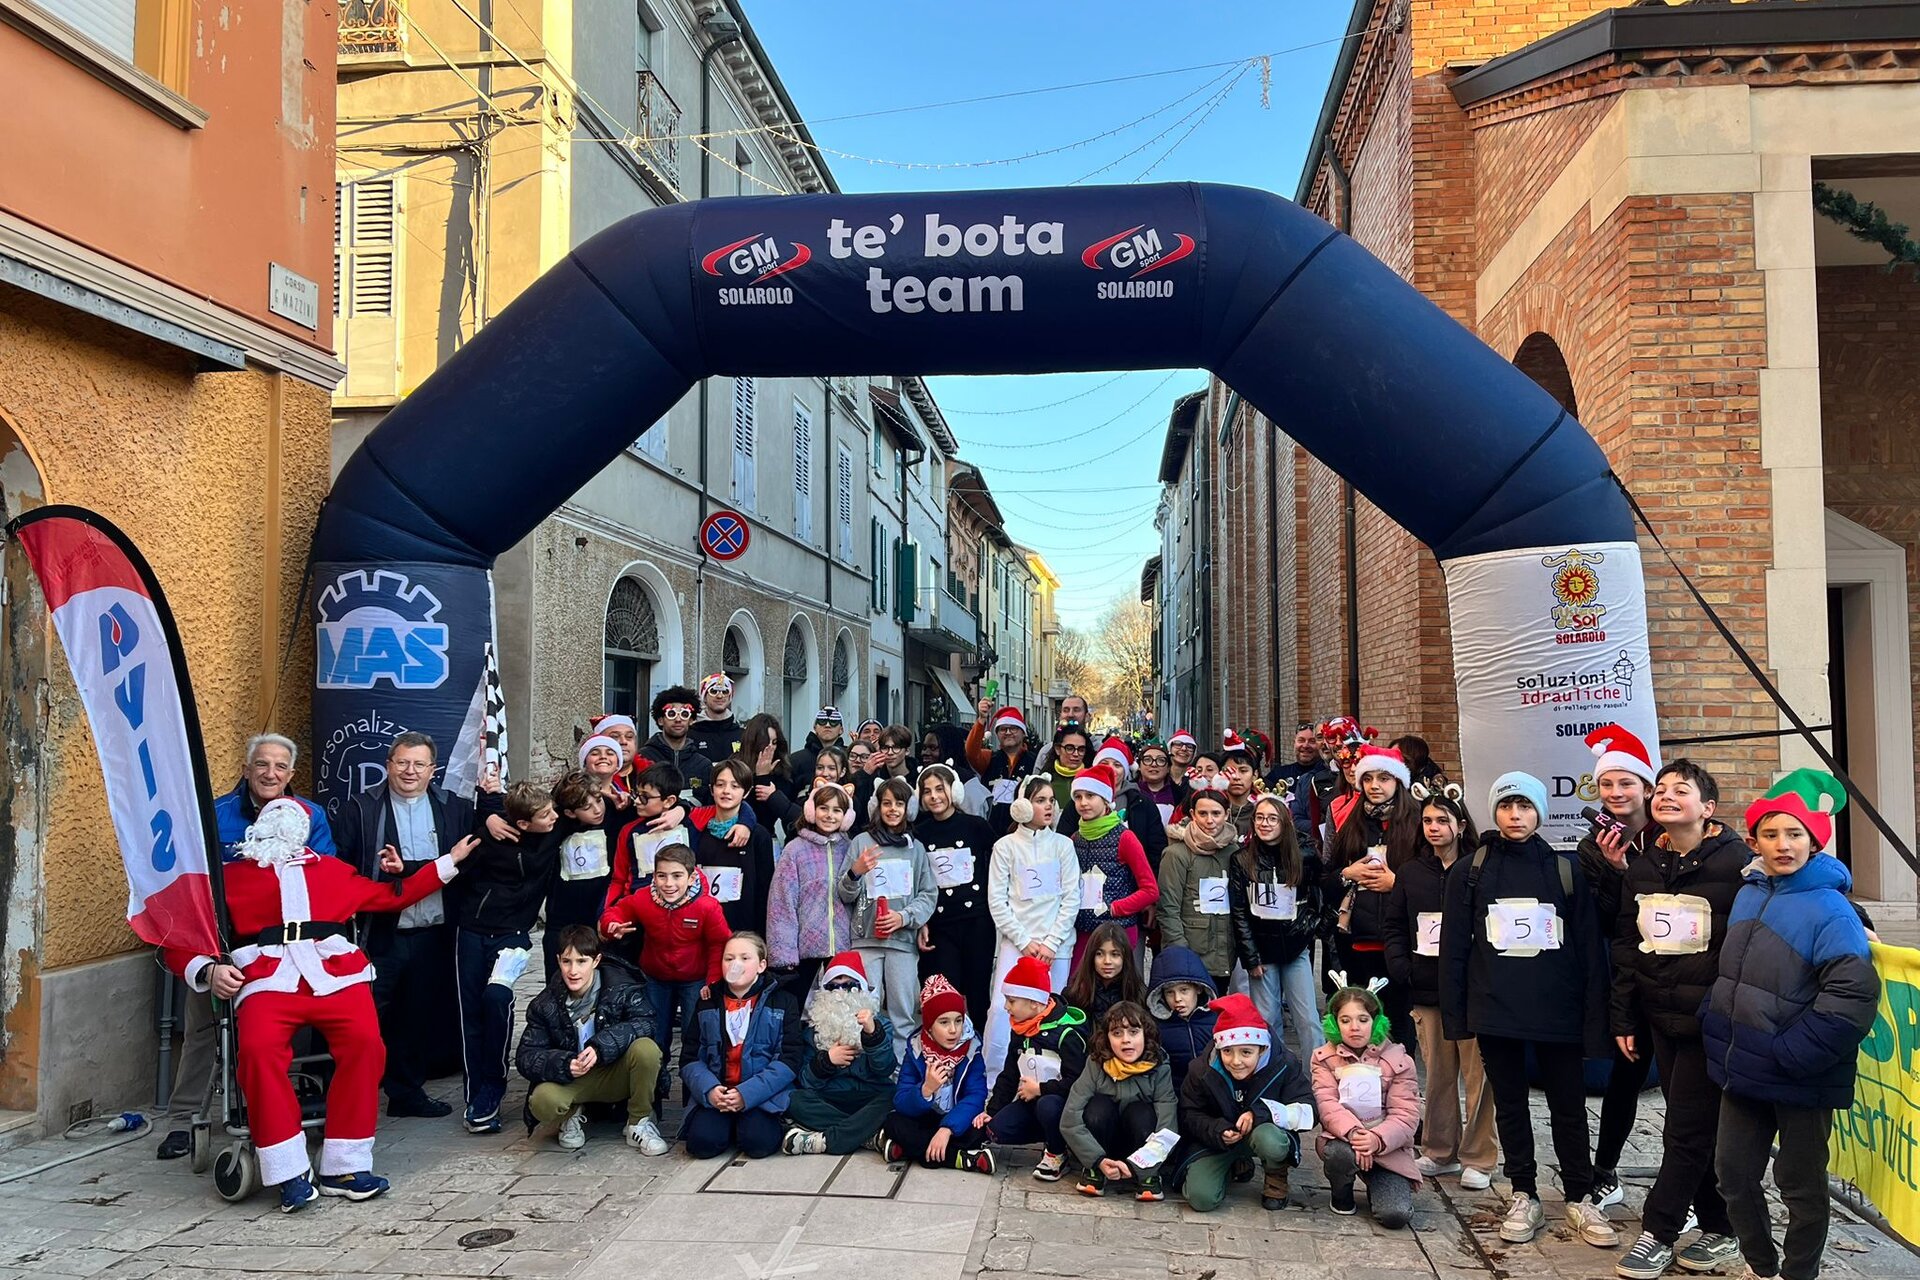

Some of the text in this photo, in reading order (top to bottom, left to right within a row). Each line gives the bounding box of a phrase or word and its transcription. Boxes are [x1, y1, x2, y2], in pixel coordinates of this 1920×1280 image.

[924, 213, 1064, 258] bota
[729, 237, 780, 275] GM
[1110, 228, 1163, 269] GM
[758, 260, 778, 275] sport
[1139, 252, 1161, 268] sport
[285, 276, 306, 293] CORSO
[866, 266, 1024, 314] team
[1097, 280, 1174, 300] SOLAROLO
[282, 292, 314, 319] MAZZINI
[718, 287, 793, 306] SOLAROLO
[1572, 613, 1597, 628] Sol
[1556, 631, 1606, 645] SOLAROLO
[317, 625, 447, 687] MAS
[1517, 670, 1607, 689] Soluzioni
[1521, 686, 1620, 705] Idrauliche
[1564, 703, 1601, 711] Pellegrino
[1556, 721, 1616, 737] SOLAR
[574, 845, 586, 867] 6
[935, 855, 954, 875] 3
[710, 873, 721, 896] 6
[874, 867, 887, 888] 3
[1026, 868, 1042, 889] 3
[1208, 885, 1226, 902] 2
[1514, 917, 1532, 940] 5
[1653, 912, 1671, 938] 5
[1340, 1079, 1373, 1103] 12
